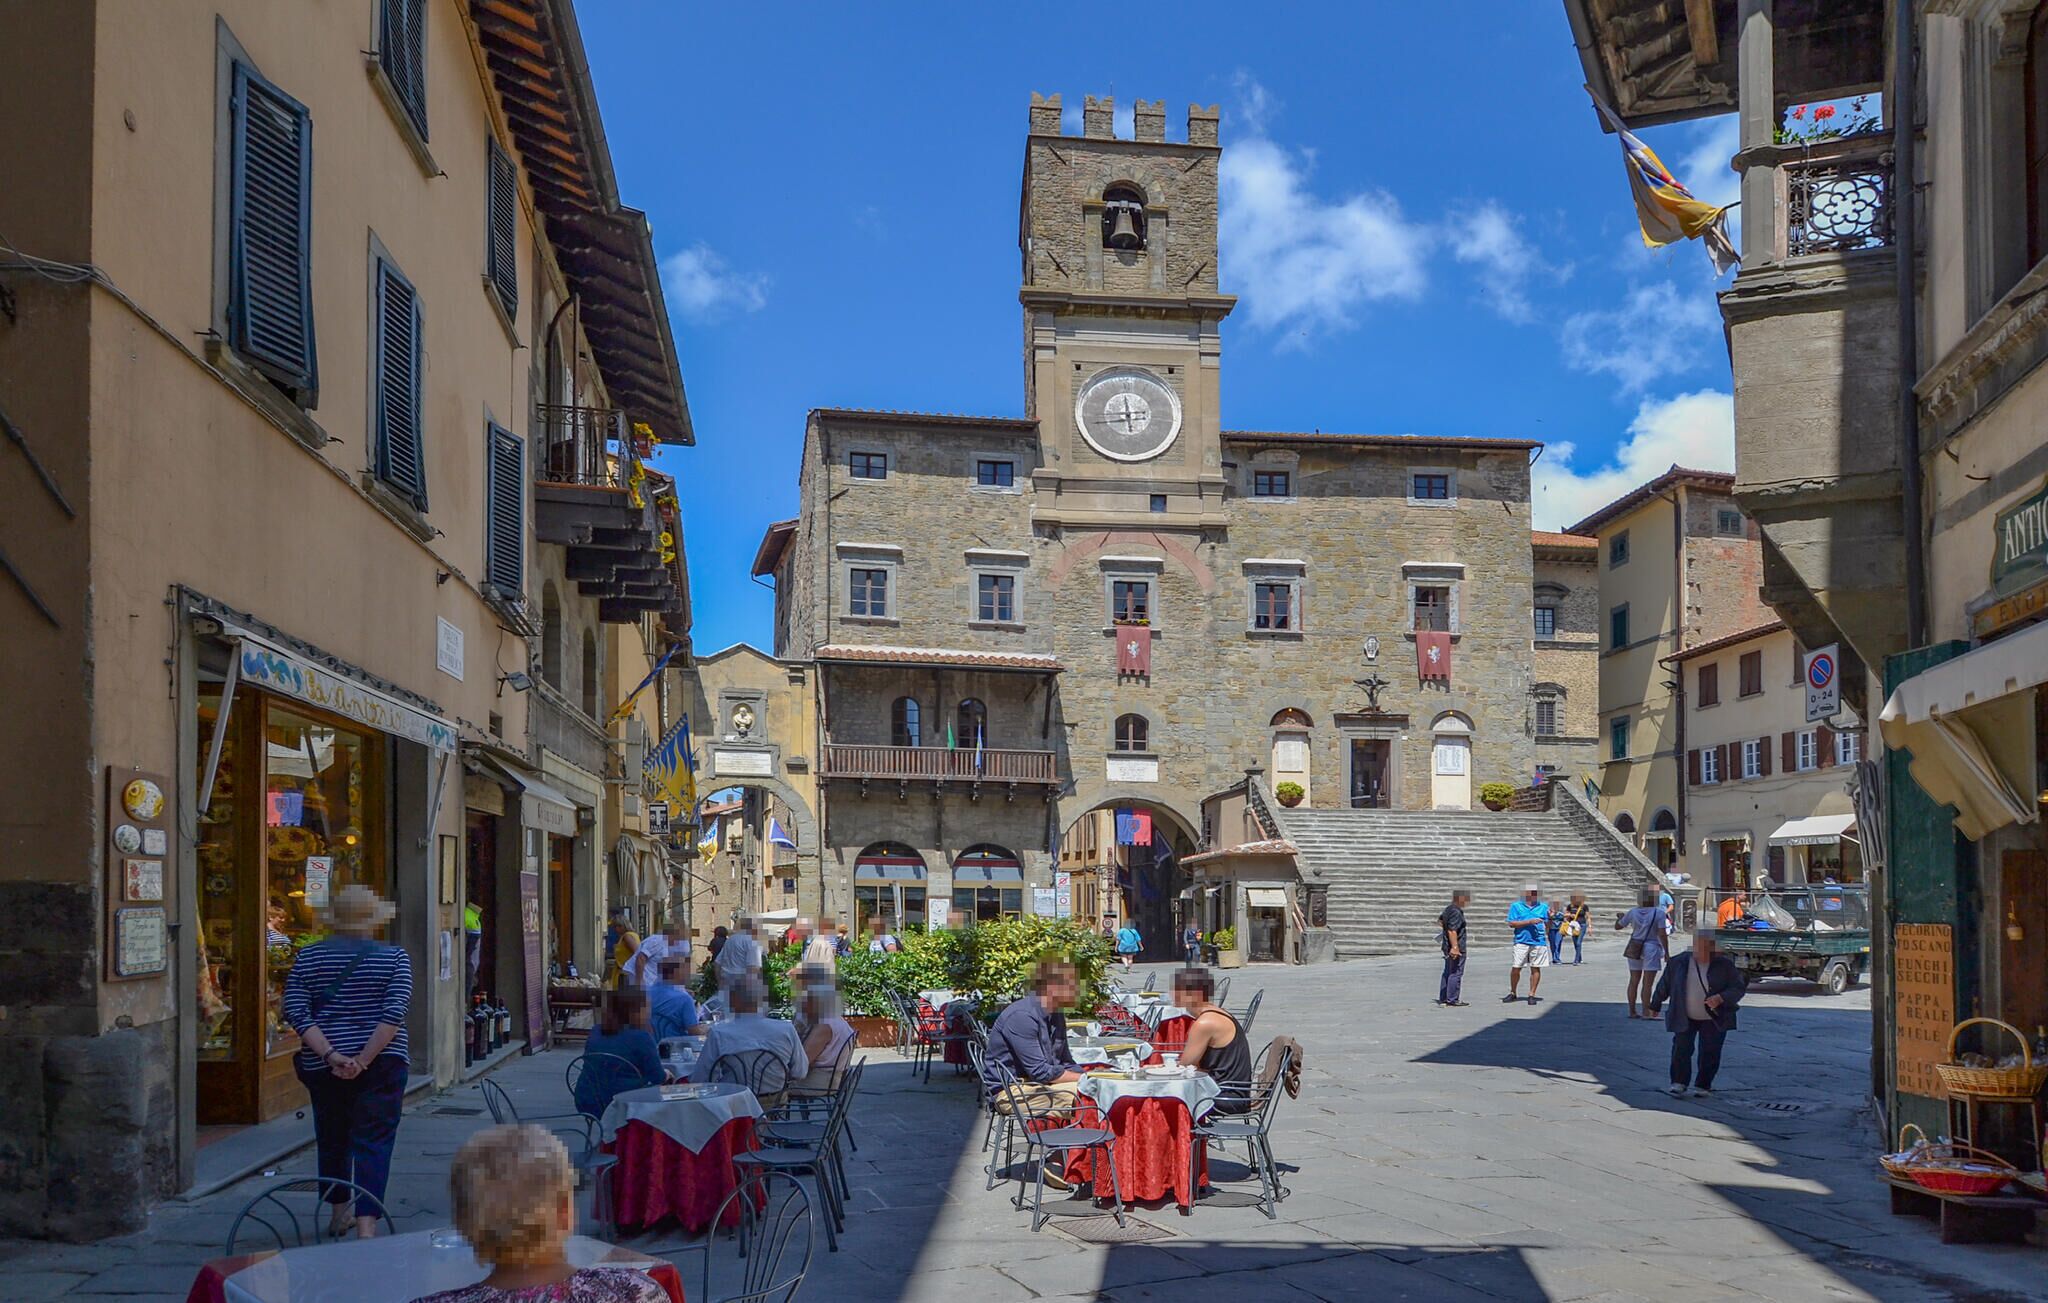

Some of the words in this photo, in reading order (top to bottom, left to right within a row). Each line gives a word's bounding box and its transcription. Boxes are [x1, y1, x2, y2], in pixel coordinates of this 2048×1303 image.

[1896, 924, 1950, 937] PECORINO
[1897, 938, 1951, 953] TOSCANO
[1897, 957, 1947, 972] FUNGHI
[1897, 970, 1947, 984] SECCHI
[1898, 991, 1939, 1008] PAPPA
[1906, 1007, 1950, 1022] REALE
[1897, 1025, 1940, 1042] MIELE
[1899, 1060, 1933, 1075] OLIO
[1899, 1075, 1940, 1091] OLIVA
